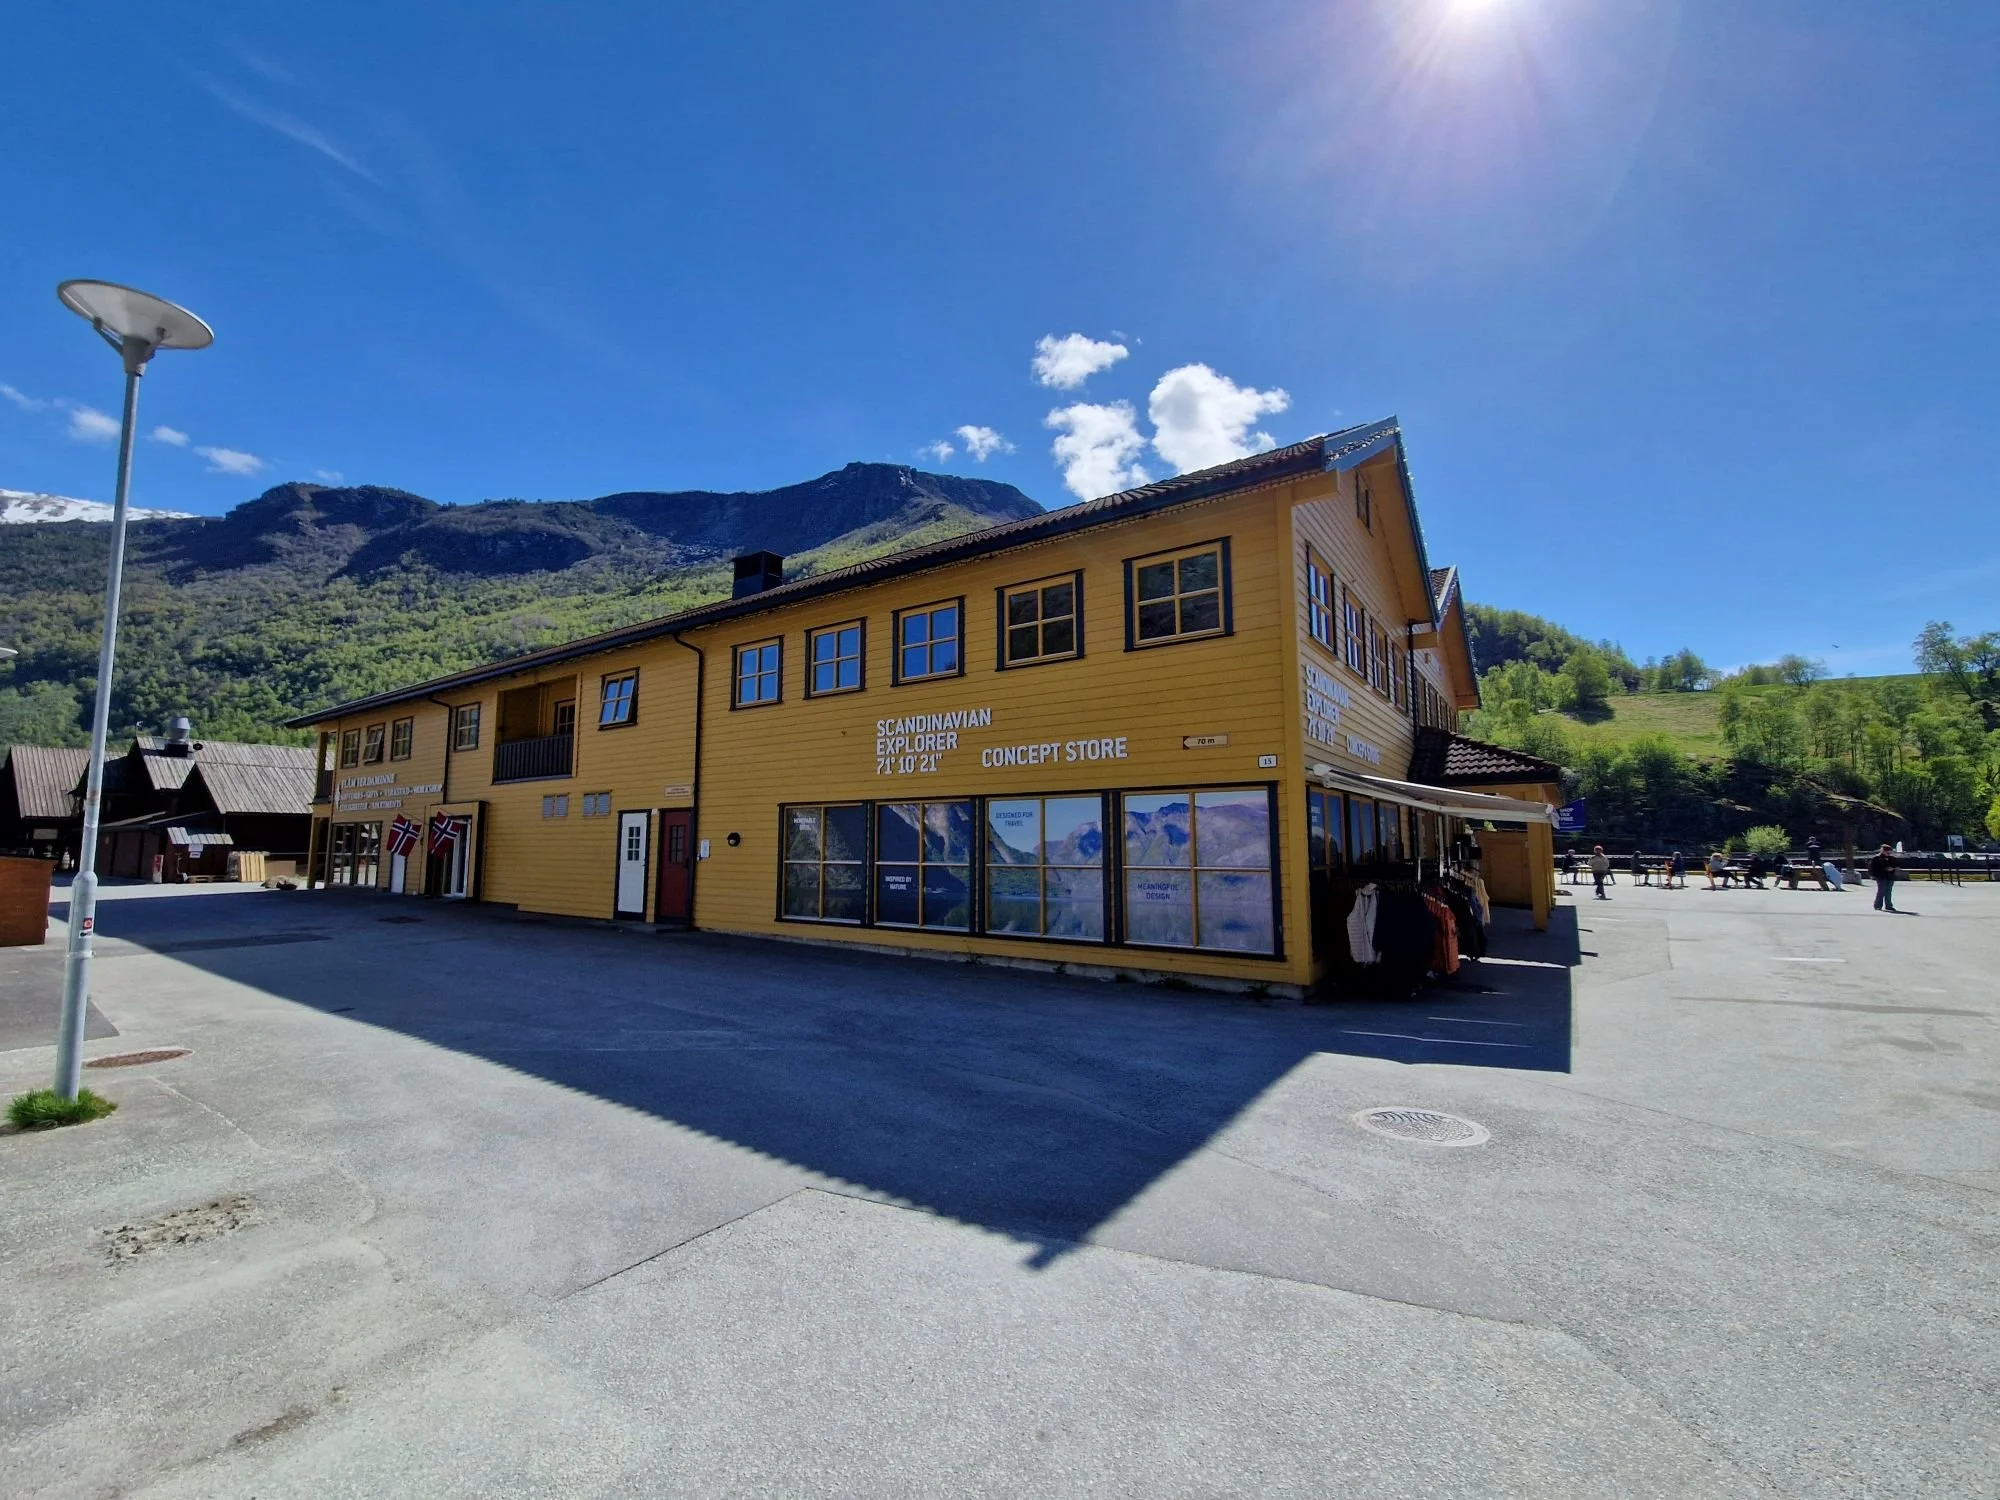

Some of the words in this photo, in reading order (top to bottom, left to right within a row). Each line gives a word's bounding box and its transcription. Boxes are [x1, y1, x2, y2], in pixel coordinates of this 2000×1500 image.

[877, 708, 991, 737] SCANDINAVIAN
[877, 732, 958, 756] EXPLORER
[982, 743, 1061, 768] CONCEPT
[1065, 737, 1128, 762] STORE
[877, 757, 896, 775] 71°
[898, 755, 918, 774] 10'
[920, 753, 942, 772] 21"
[996, 811, 1021, 819] DESIGNED
[1138, 882, 1178, 891] MEANINGFUL
[1146, 892, 1170, 900] DESIGN
